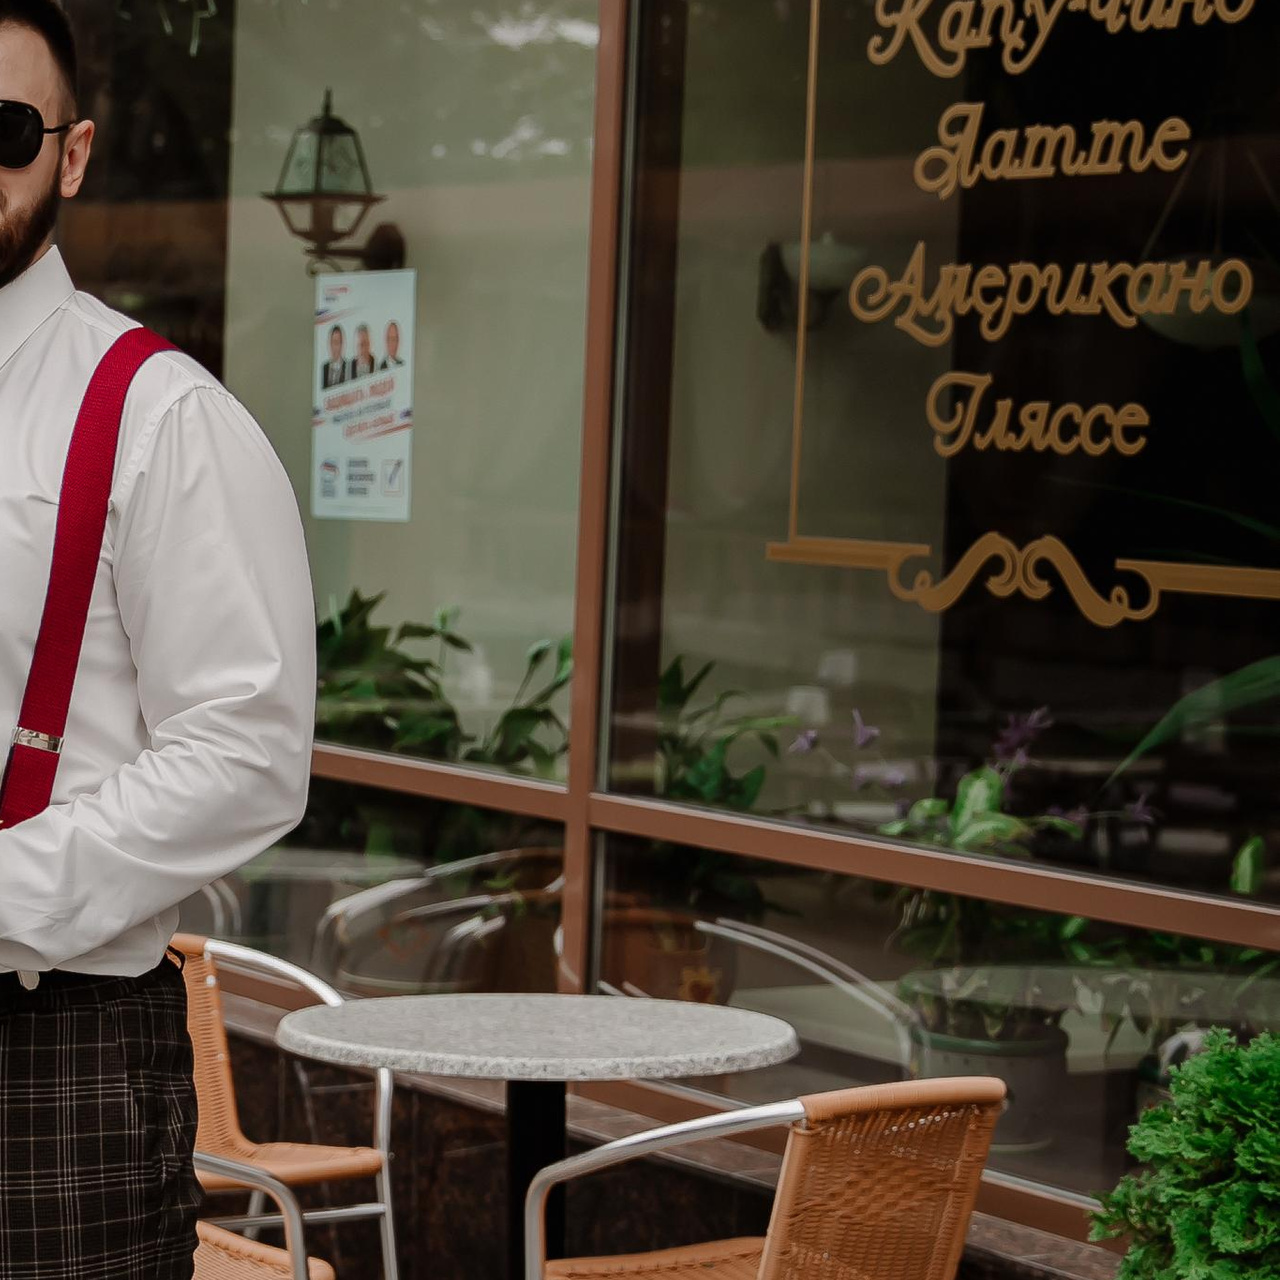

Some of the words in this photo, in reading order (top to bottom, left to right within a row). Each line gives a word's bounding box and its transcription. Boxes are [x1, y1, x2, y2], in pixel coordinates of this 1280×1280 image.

[913, 101, 1191, 200] Латте
[848, 241, 1254, 347] Американо
[926, 371, 1151, 457] Гляссе
